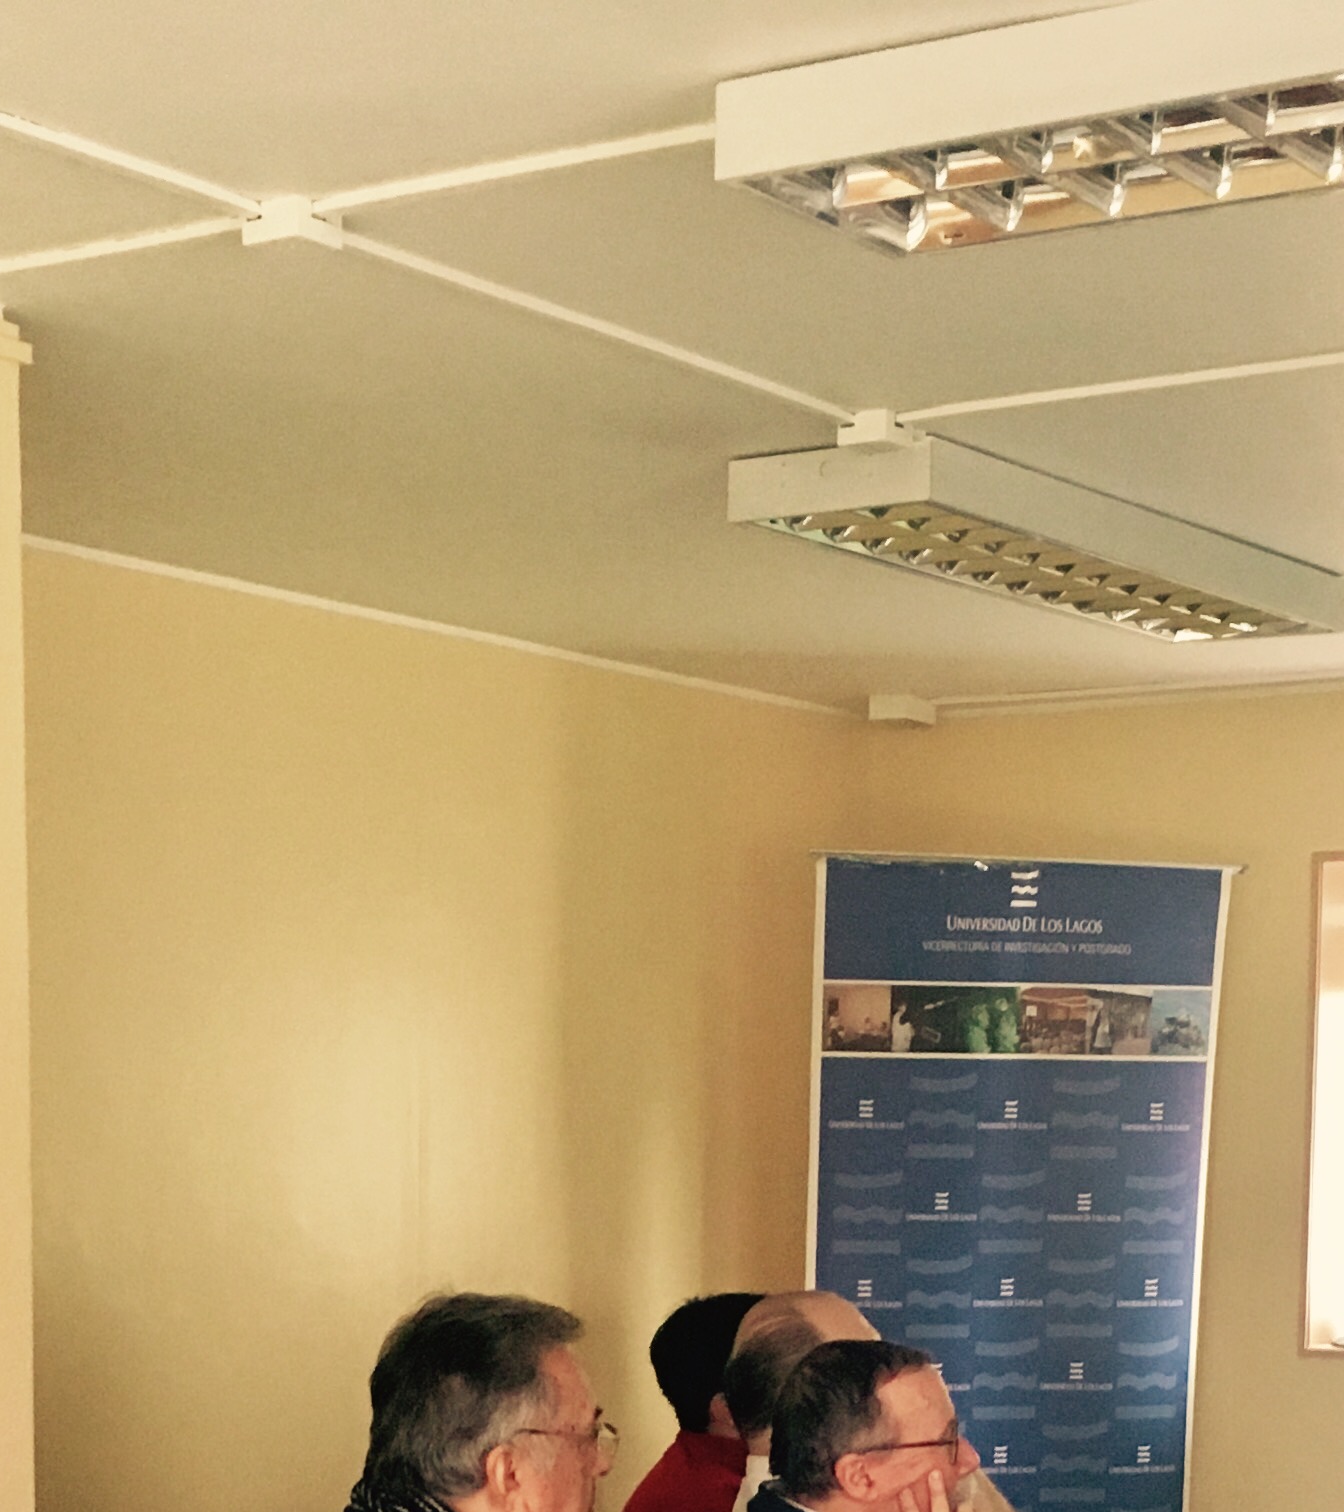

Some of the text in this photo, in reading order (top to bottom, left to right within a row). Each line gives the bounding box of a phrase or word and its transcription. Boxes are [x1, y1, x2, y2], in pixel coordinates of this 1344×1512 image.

[947, 915, 1103, 934] UNIVERSIDAD DE LOS LAGOS
